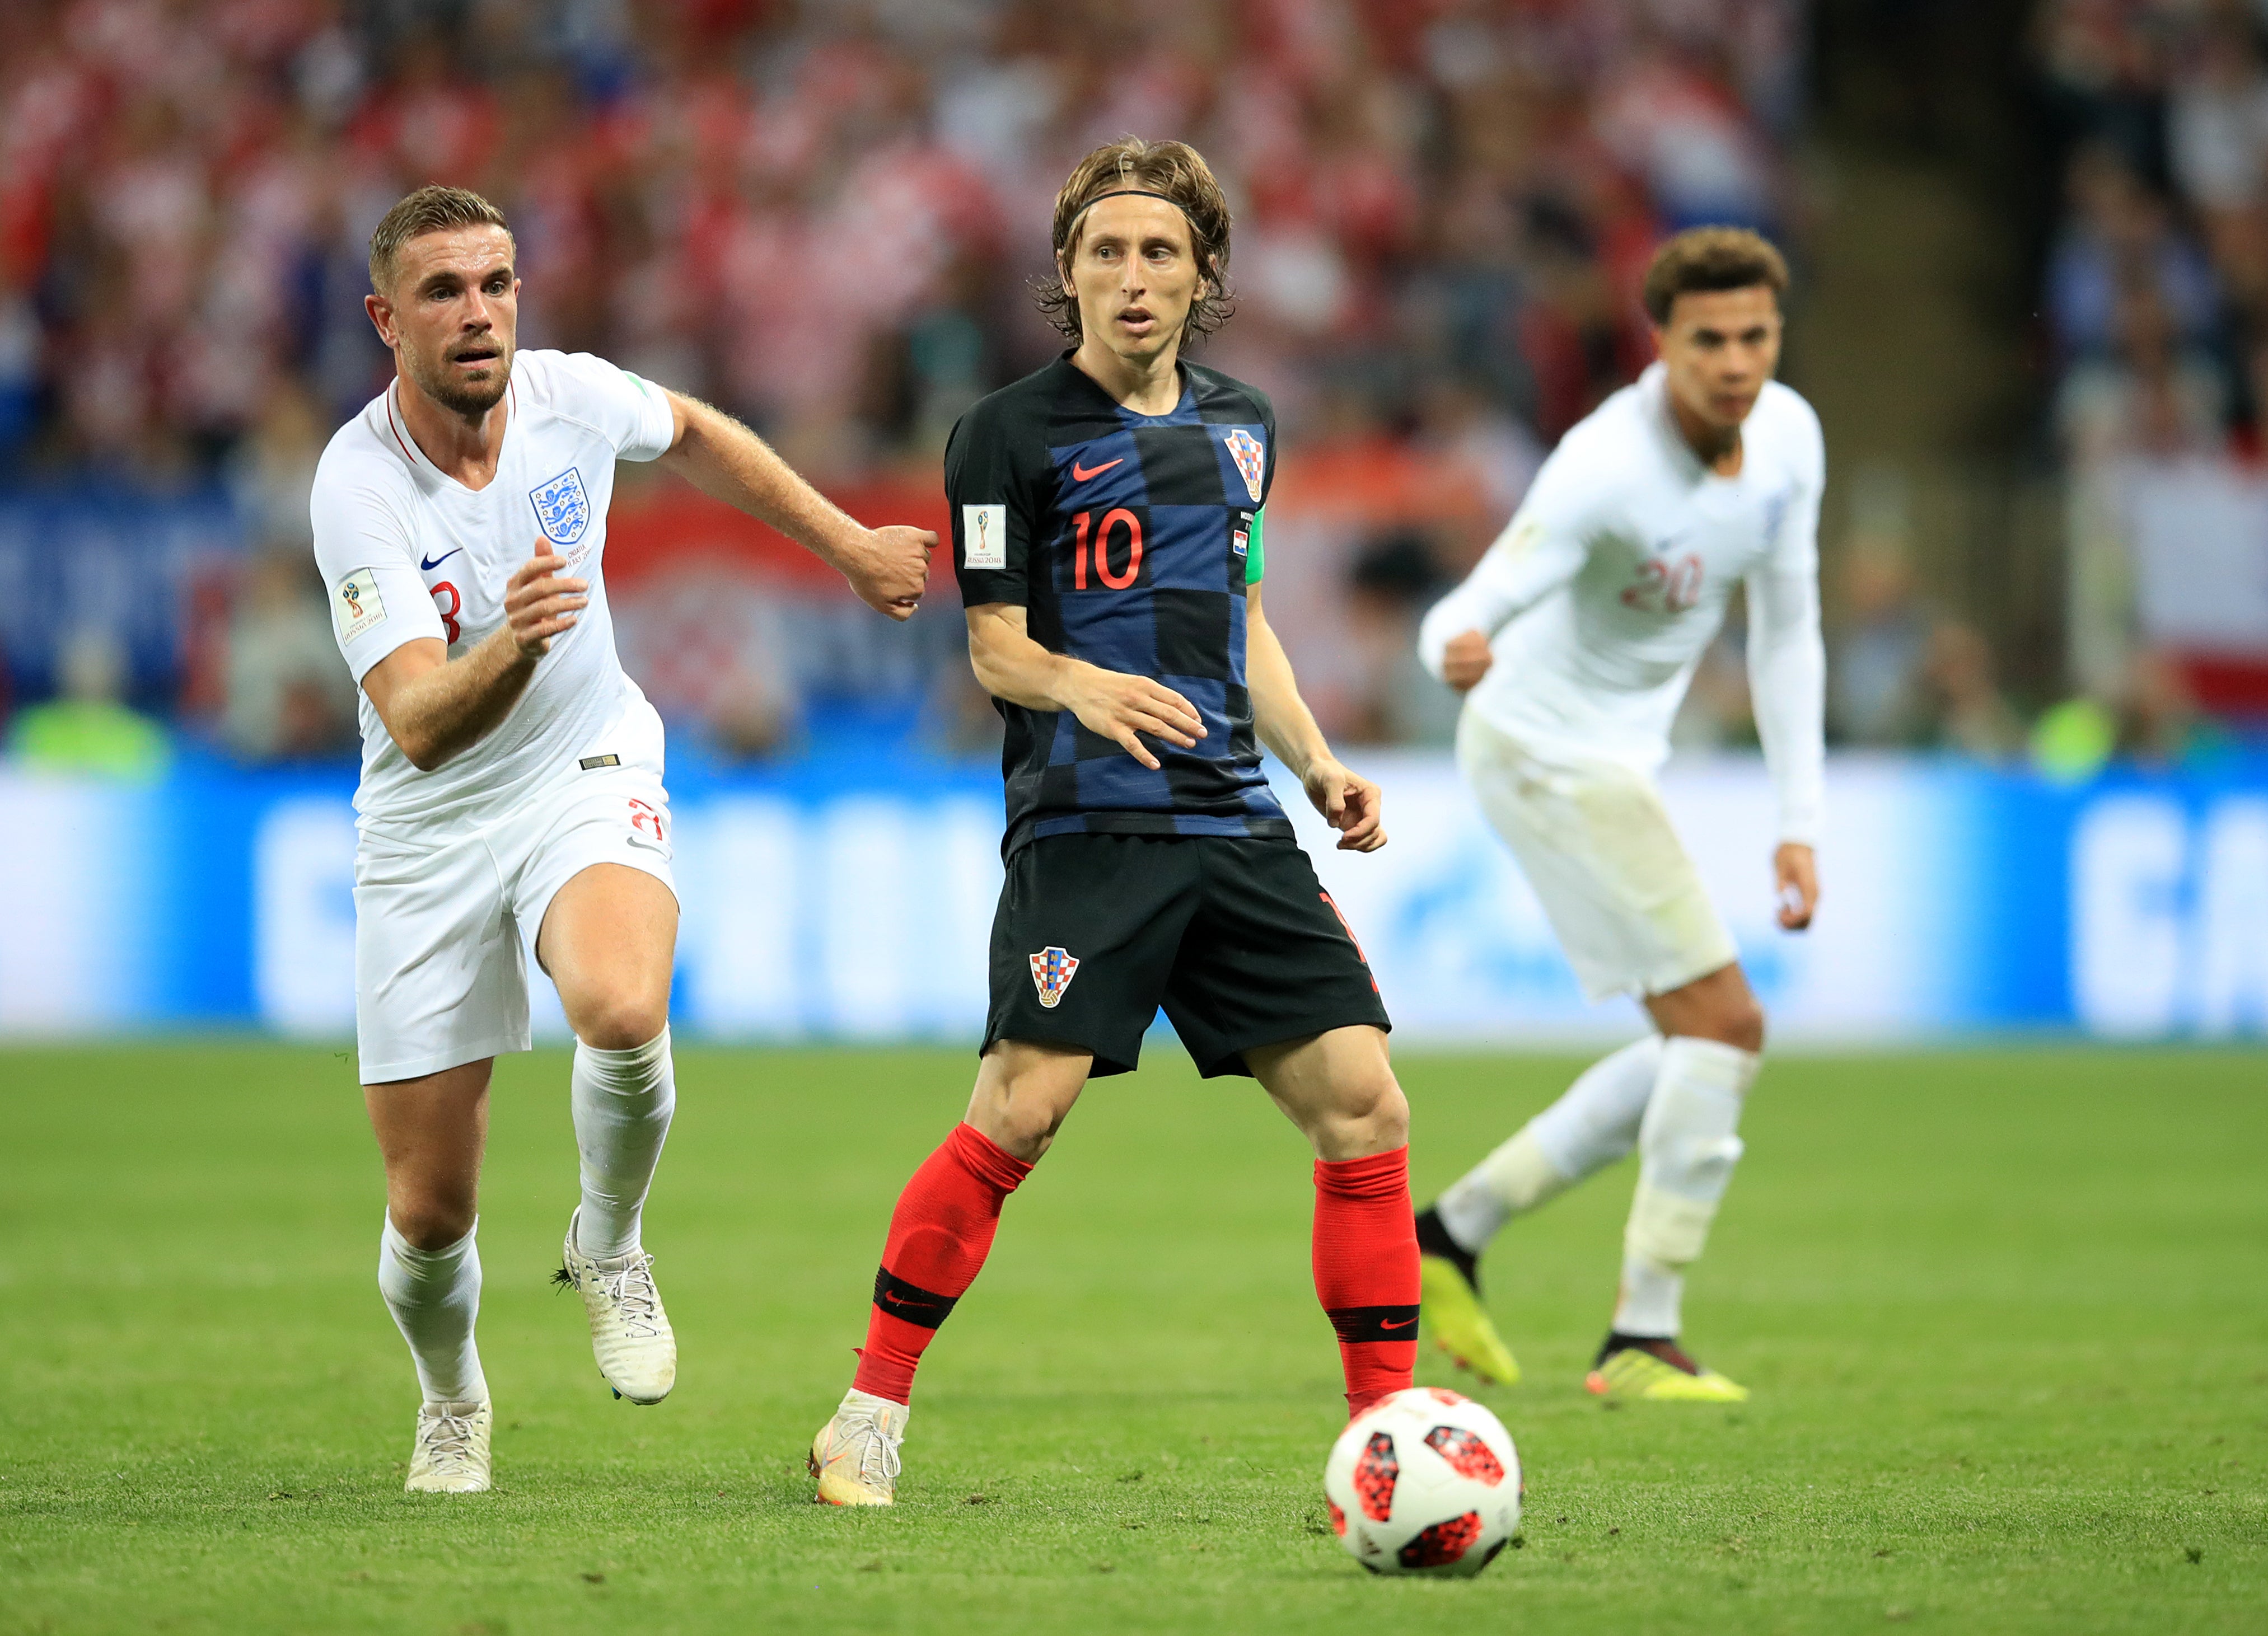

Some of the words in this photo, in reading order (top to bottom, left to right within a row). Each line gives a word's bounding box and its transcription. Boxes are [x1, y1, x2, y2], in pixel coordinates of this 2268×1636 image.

[1072, 508, 1143, 590] 10
[1620, 554, 1704, 612] 20
[344, 622, 367, 641] RUSSIA
